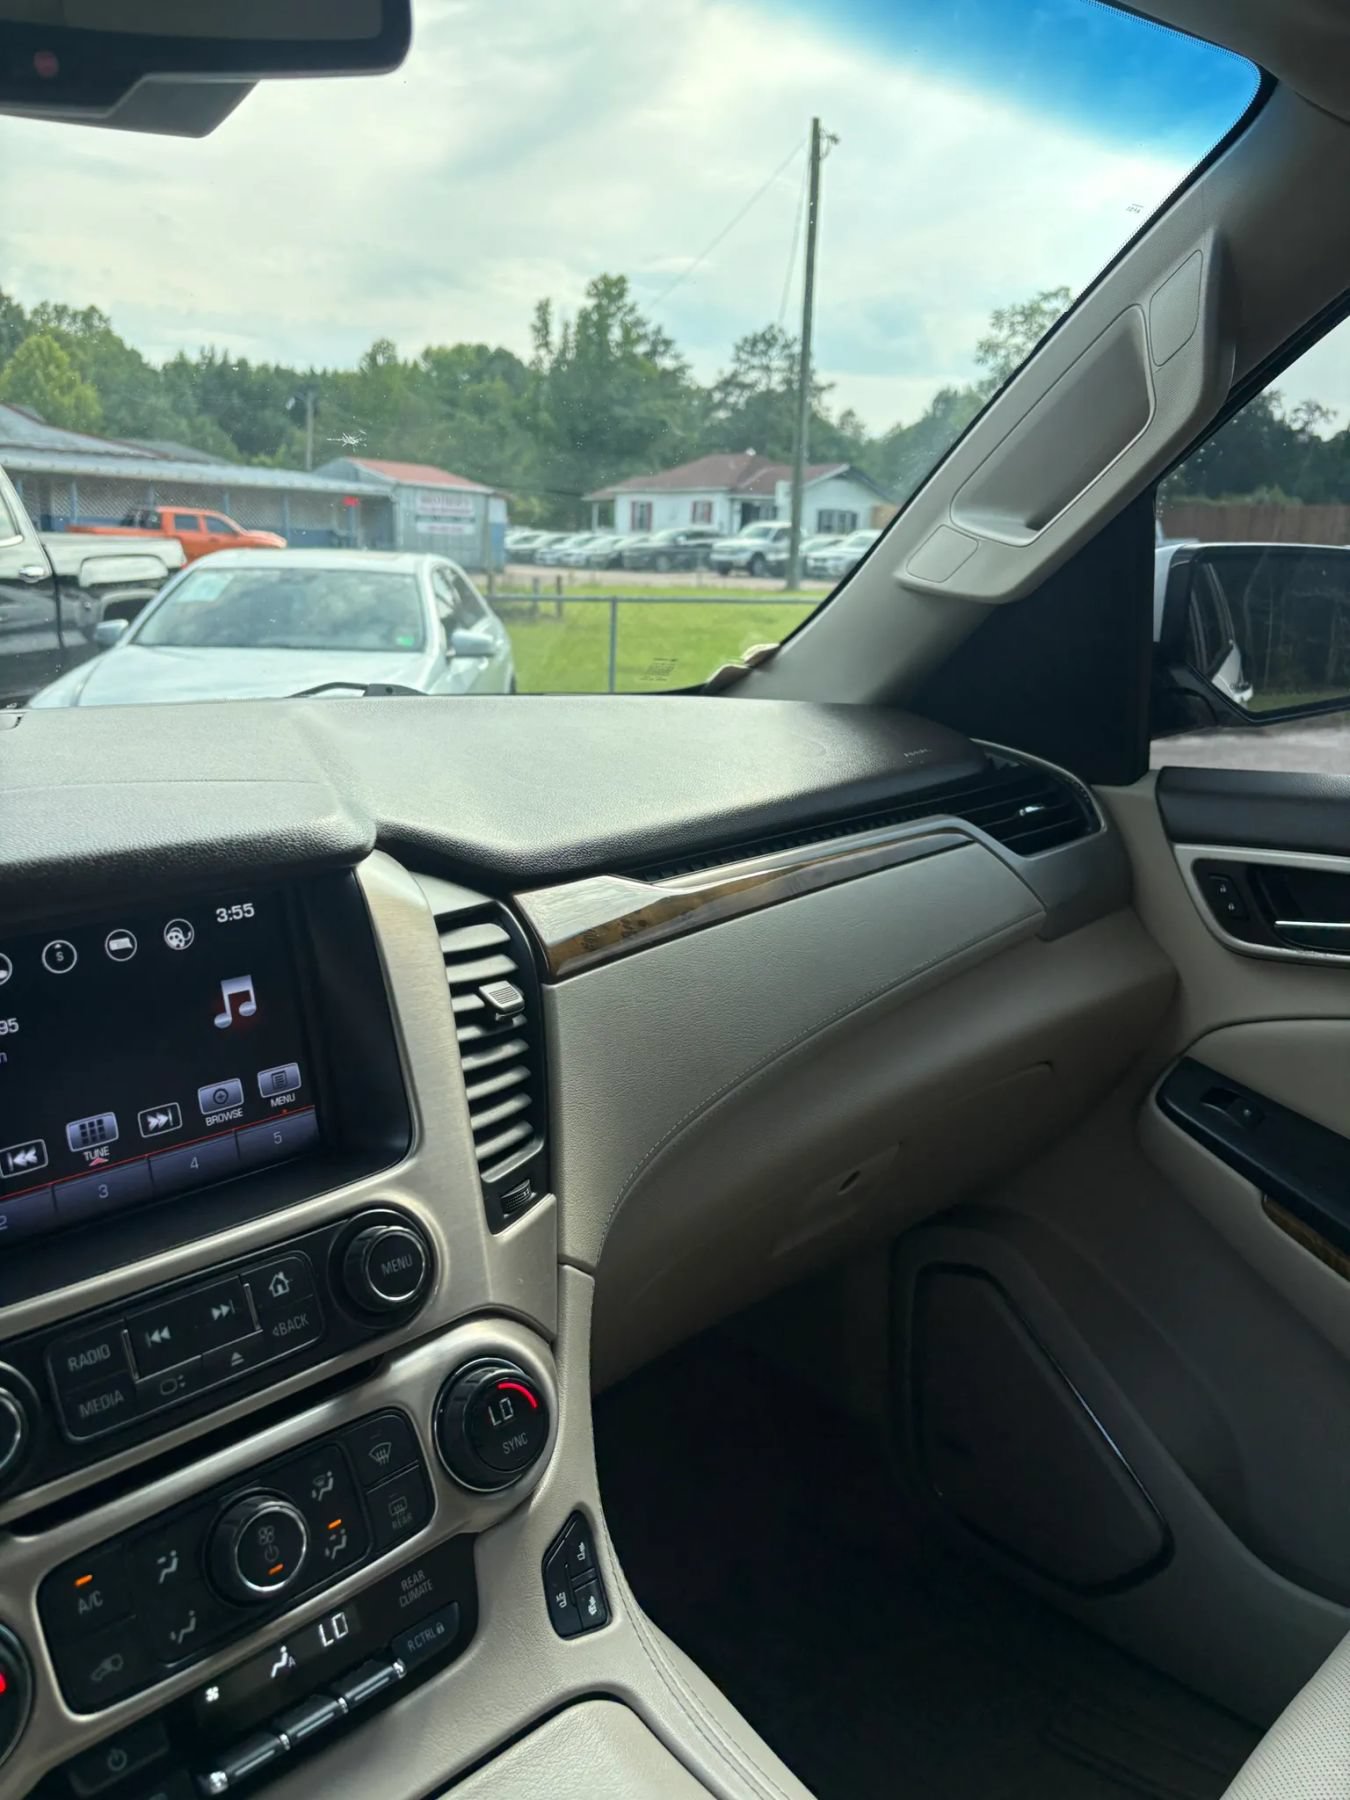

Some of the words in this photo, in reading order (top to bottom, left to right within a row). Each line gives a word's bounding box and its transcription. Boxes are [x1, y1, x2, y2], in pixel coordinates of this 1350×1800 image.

[216, 903, 255, 922] 3:55
[270, 1093, 296, 1107] MENU
[205, 1109, 243, 1126] BROWSE
[273, 1132, 282, 1144] 5
[83, 1147, 110, 1161] TUNE
[190, 1157, 199, 1169] 4
[99, 1184, 109, 1198] 3
[381, 1254, 413, 1275] MENU
[280, 1313, 309, 1336] BACK
[68, 1344, 111, 1371] RADIO
[79, 1390, 125, 1418] MEDIA
[502, 1432, 529, 1455] SYNC
[400, 1569, 426, 1591] REAR
[78, 1591, 104, 1615] A/C
[399, 1578, 433, 1608] CLIMATE
